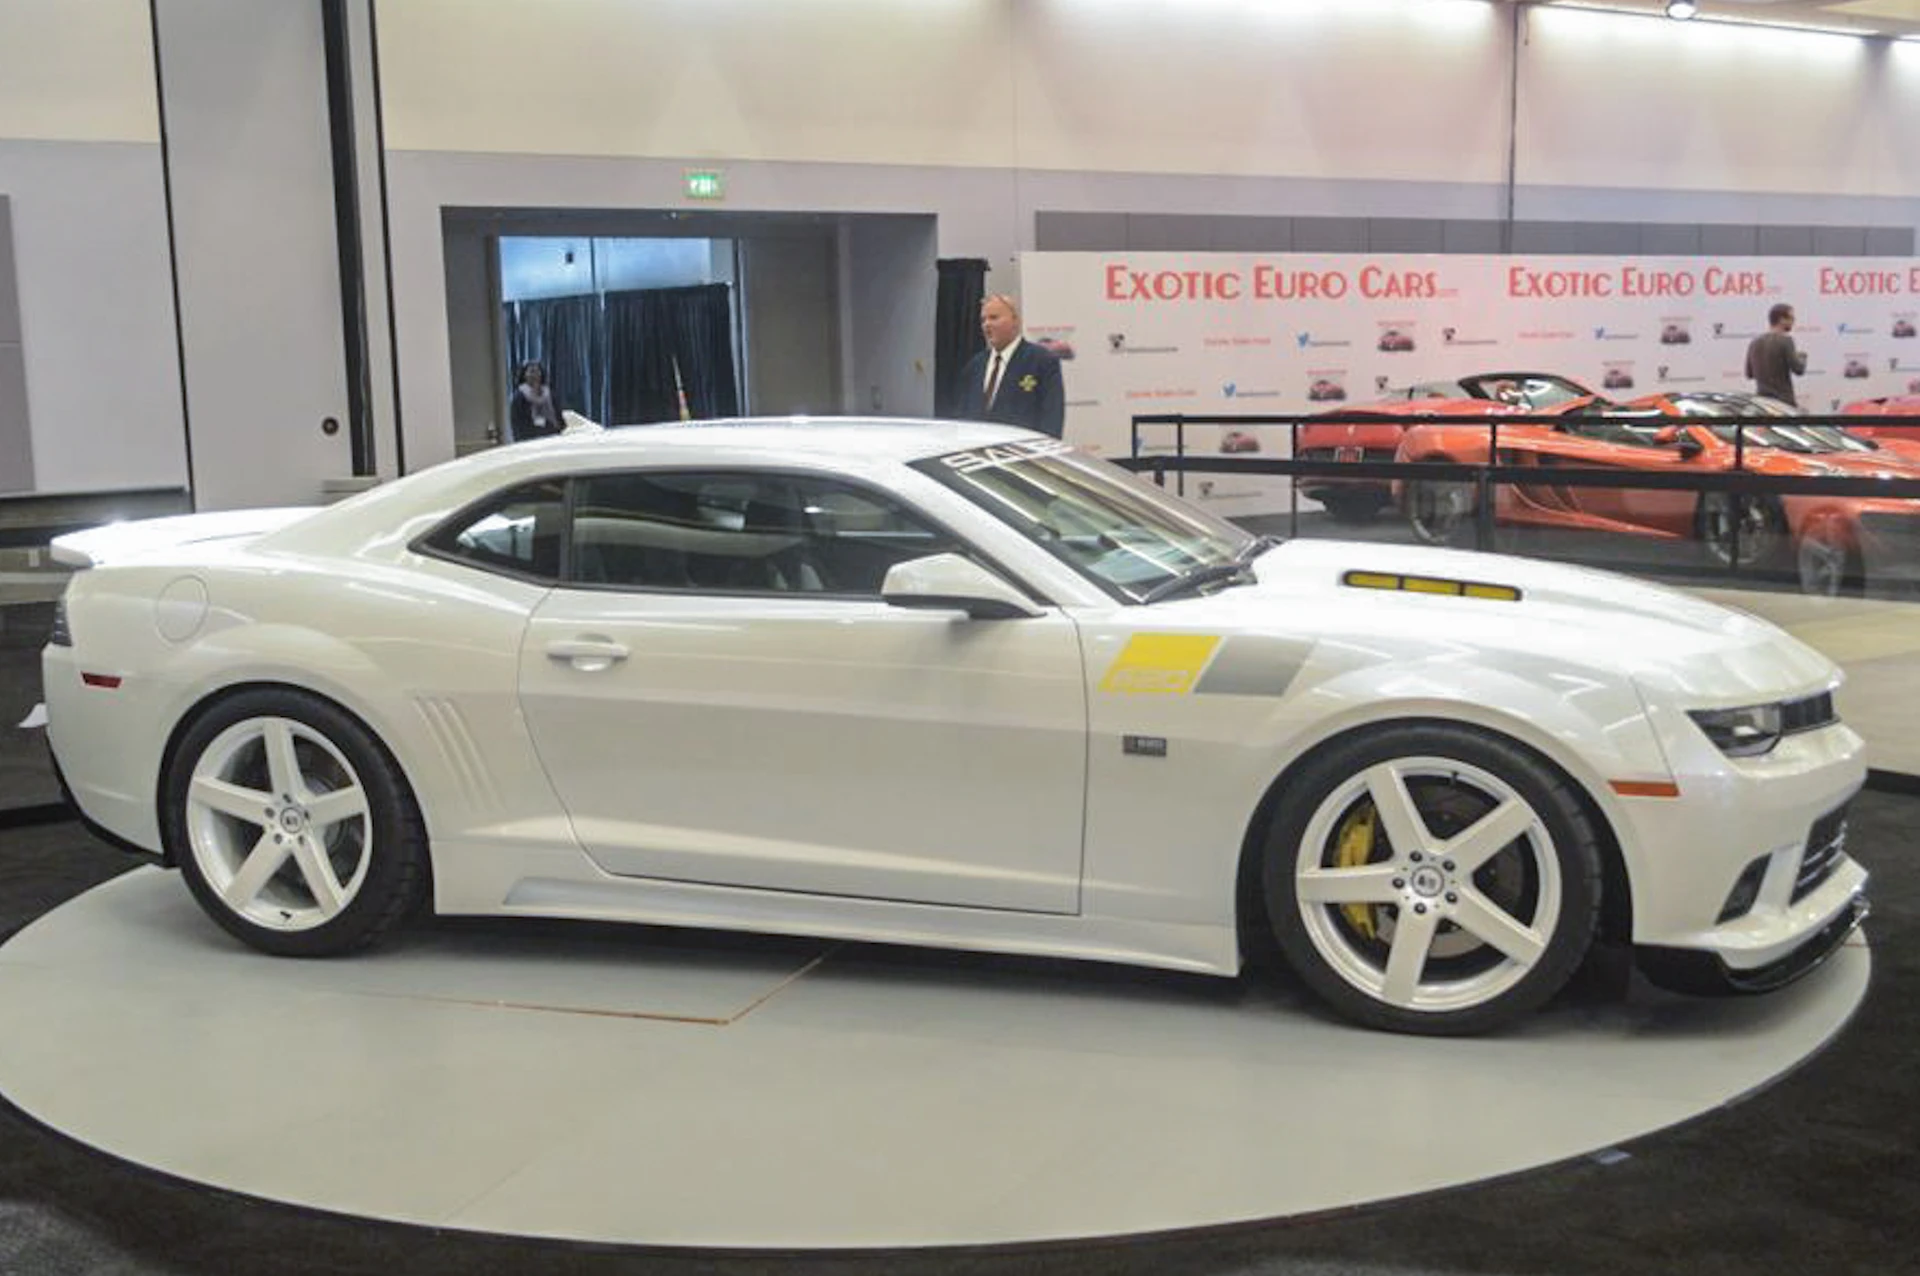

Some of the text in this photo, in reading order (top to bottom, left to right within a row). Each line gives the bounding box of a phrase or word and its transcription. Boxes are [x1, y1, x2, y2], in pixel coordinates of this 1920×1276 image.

[1106, 264, 1436, 301] EXOTIC EURO CARS
[1509, 266, 1765, 297] EXOTIC EURO CARS
